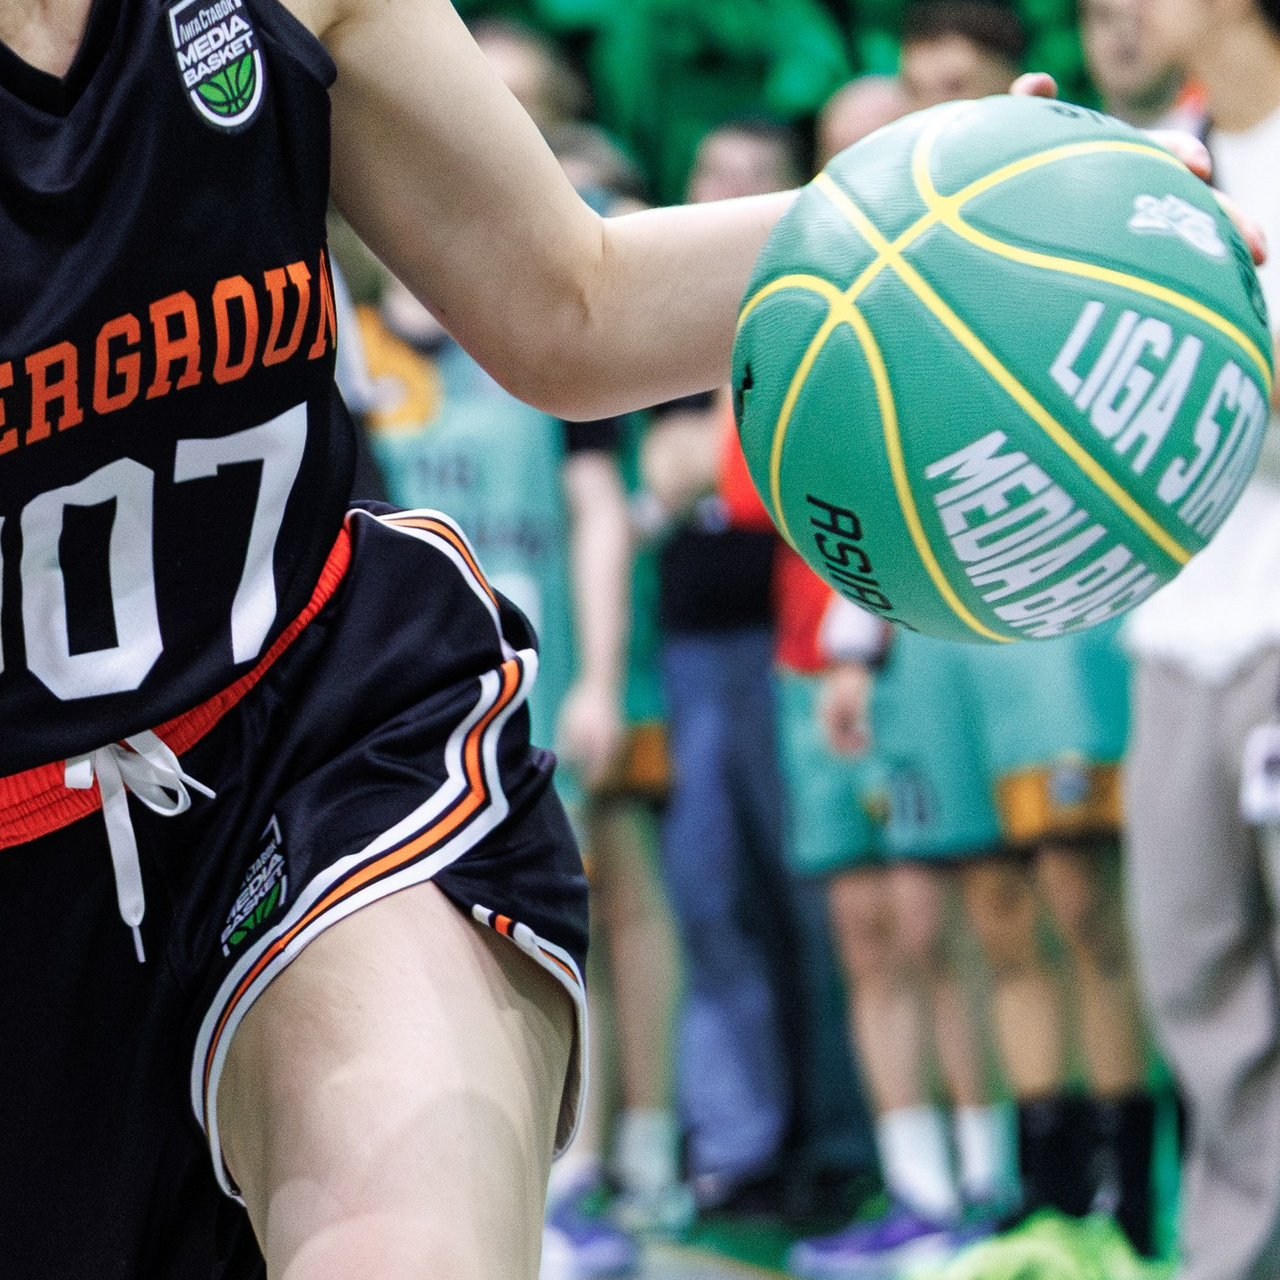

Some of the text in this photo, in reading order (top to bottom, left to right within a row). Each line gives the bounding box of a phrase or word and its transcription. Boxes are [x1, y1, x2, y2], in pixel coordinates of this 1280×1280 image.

[177, 14, 250, 72] MEDIA
[183, 29, 254, 89] BASKET
[1049, 300, 1203, 476] LIGA
[924, 429, 1108, 604] MEDIA
